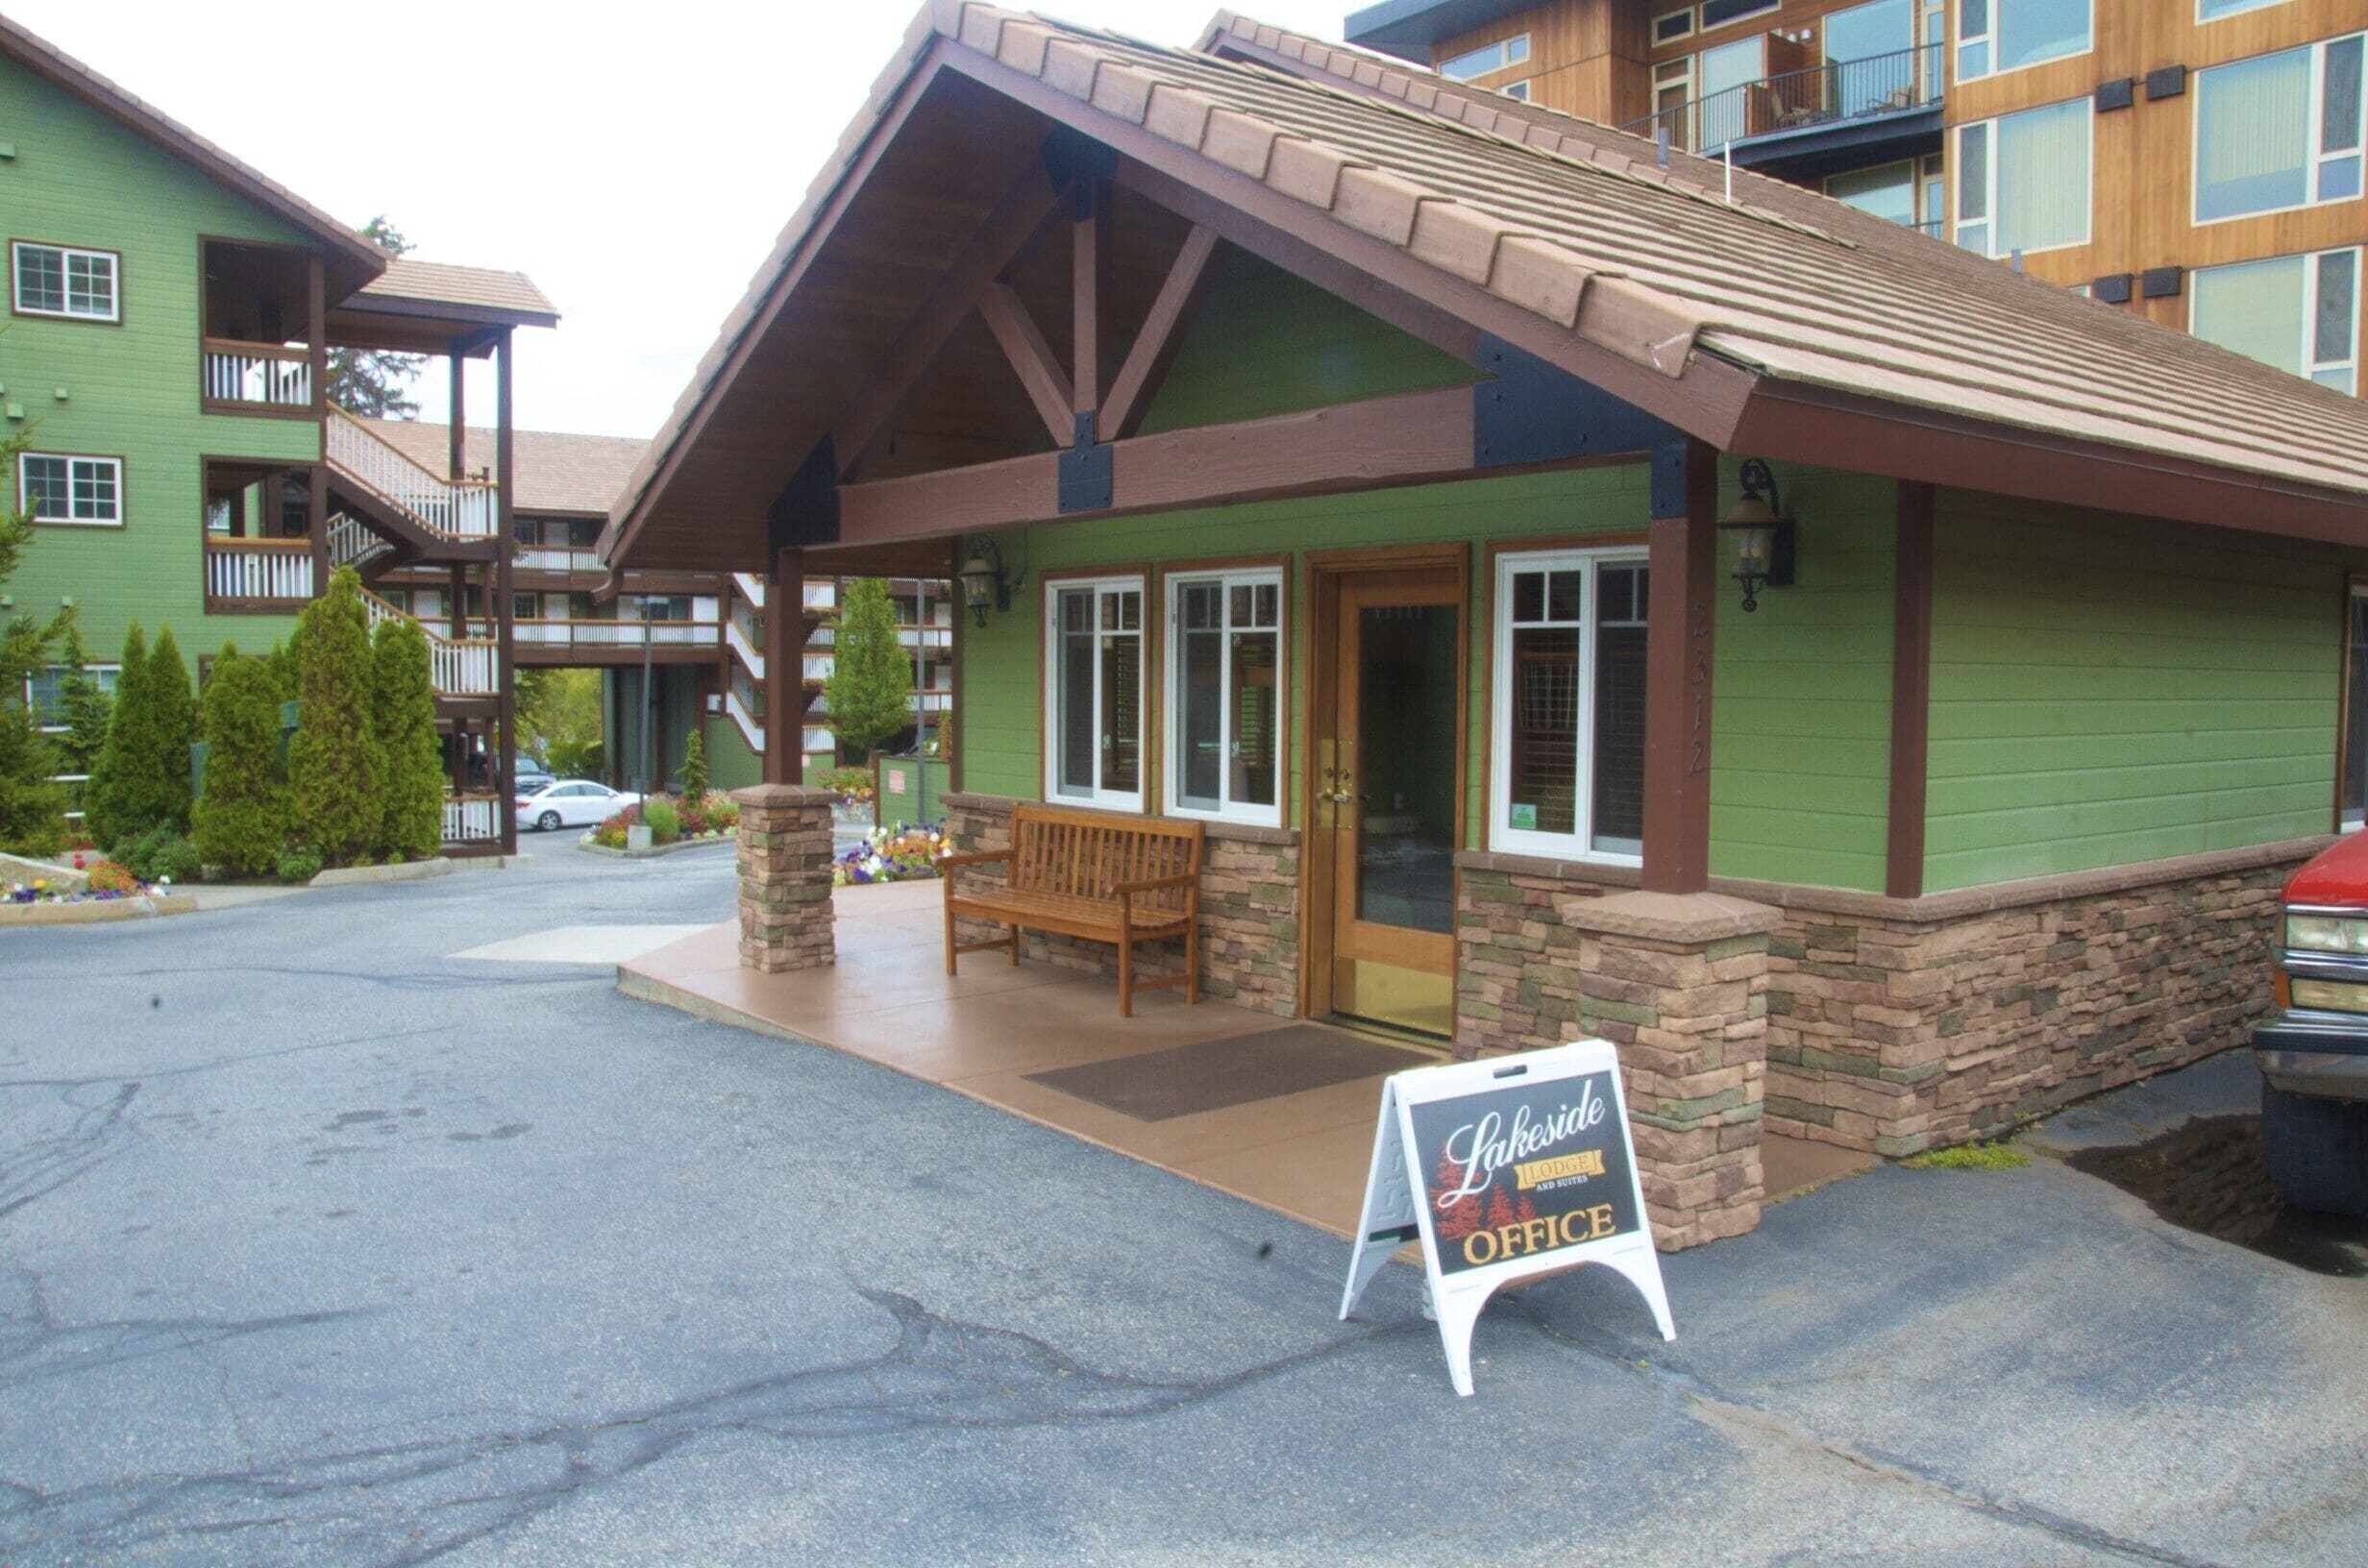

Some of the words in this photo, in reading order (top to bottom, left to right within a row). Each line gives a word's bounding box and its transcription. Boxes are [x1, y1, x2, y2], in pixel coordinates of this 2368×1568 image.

[1438, 1079, 1606, 1208] Lakeside
[1529, 1155, 1590, 1180] LODGE
[1536, 1181, 1556, 1192] AND
[1557, 1174, 1589, 1188] SUITES
[1463, 1204, 1616, 1265] OFFICE
